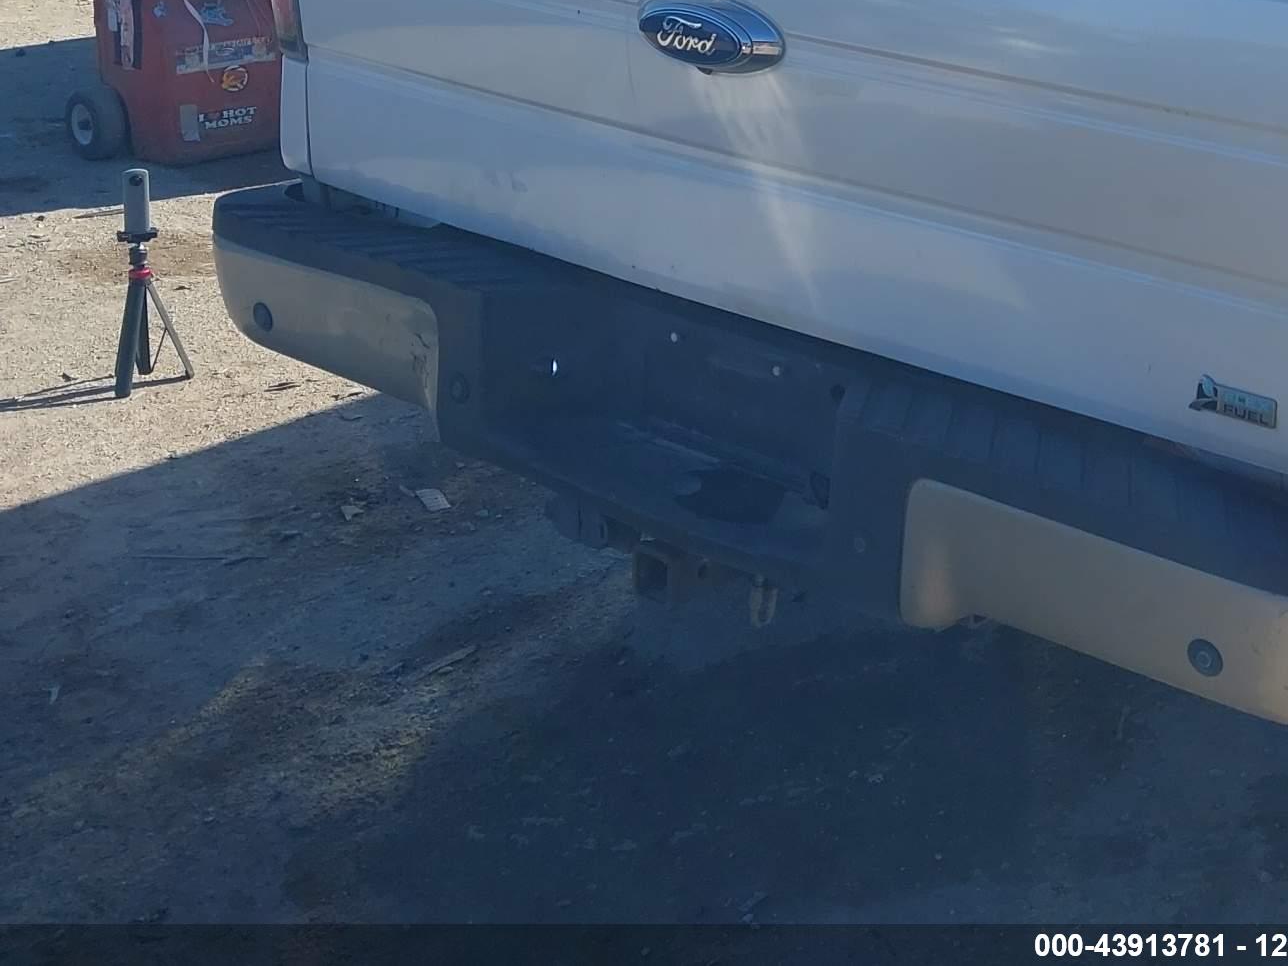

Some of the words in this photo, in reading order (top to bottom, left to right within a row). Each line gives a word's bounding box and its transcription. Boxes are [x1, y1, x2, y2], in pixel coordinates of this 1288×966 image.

[657, 15, 717, 55] Ford
[222, 106, 257, 119] HOT
[205, 115, 253, 130] MOMS
[1223, 403, 1270, 427] FUEL
